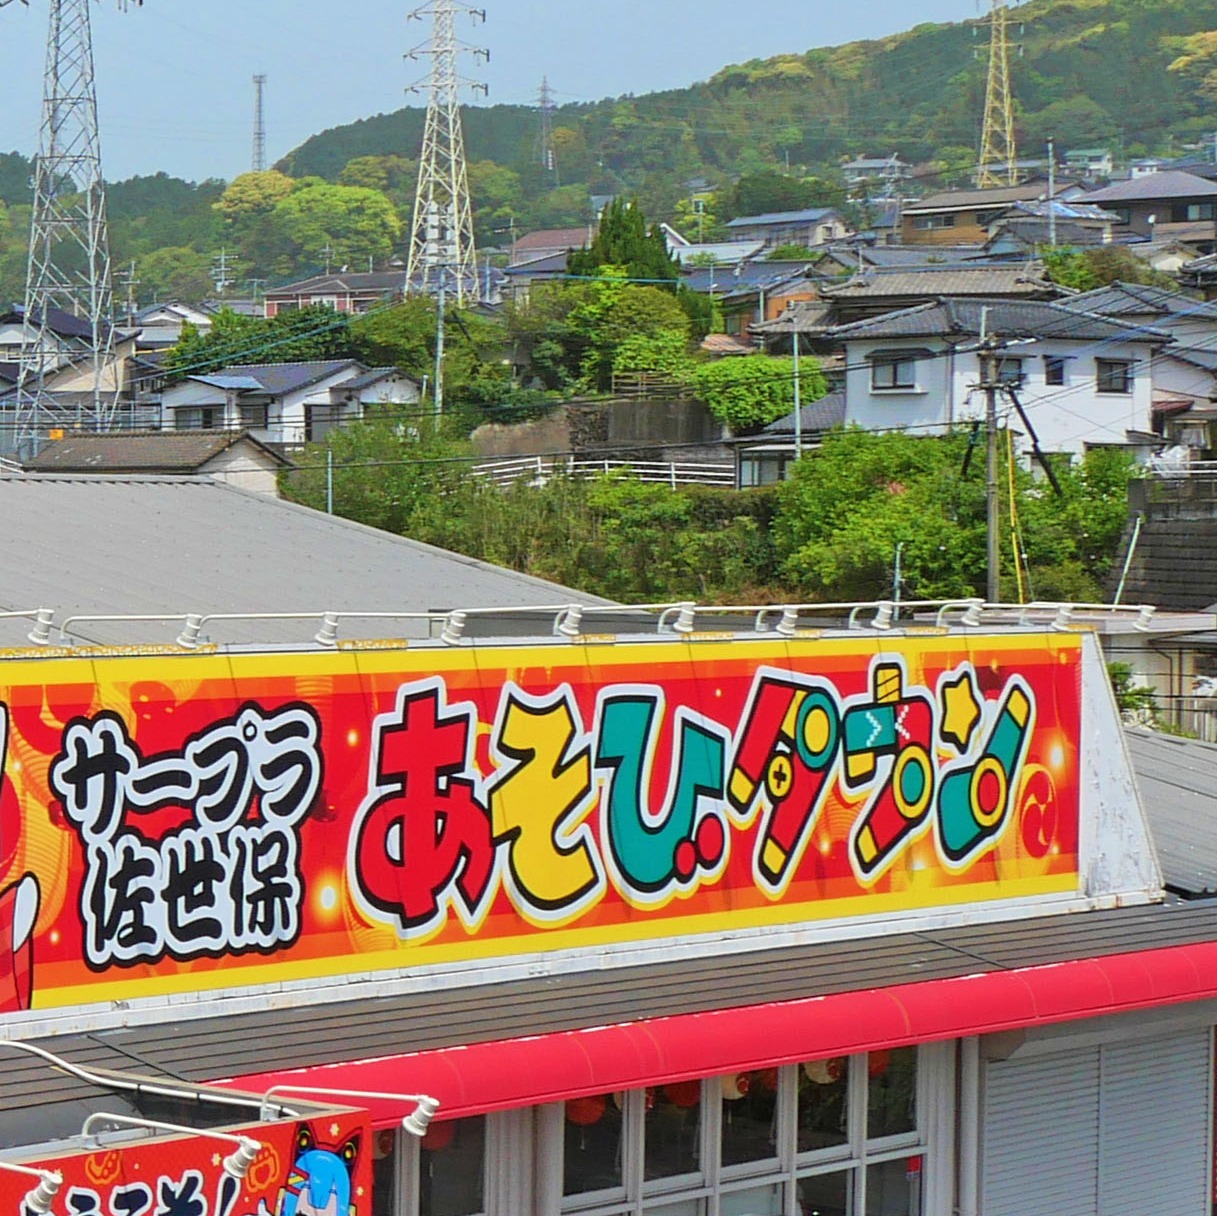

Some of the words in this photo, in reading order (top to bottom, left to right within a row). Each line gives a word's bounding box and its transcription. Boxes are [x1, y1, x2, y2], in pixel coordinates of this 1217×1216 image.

[56, 704, 320, 836] サープラ
[350, 656, 1033, 934] あそびタウン
[82, 826, 304, 966] 佐世保
